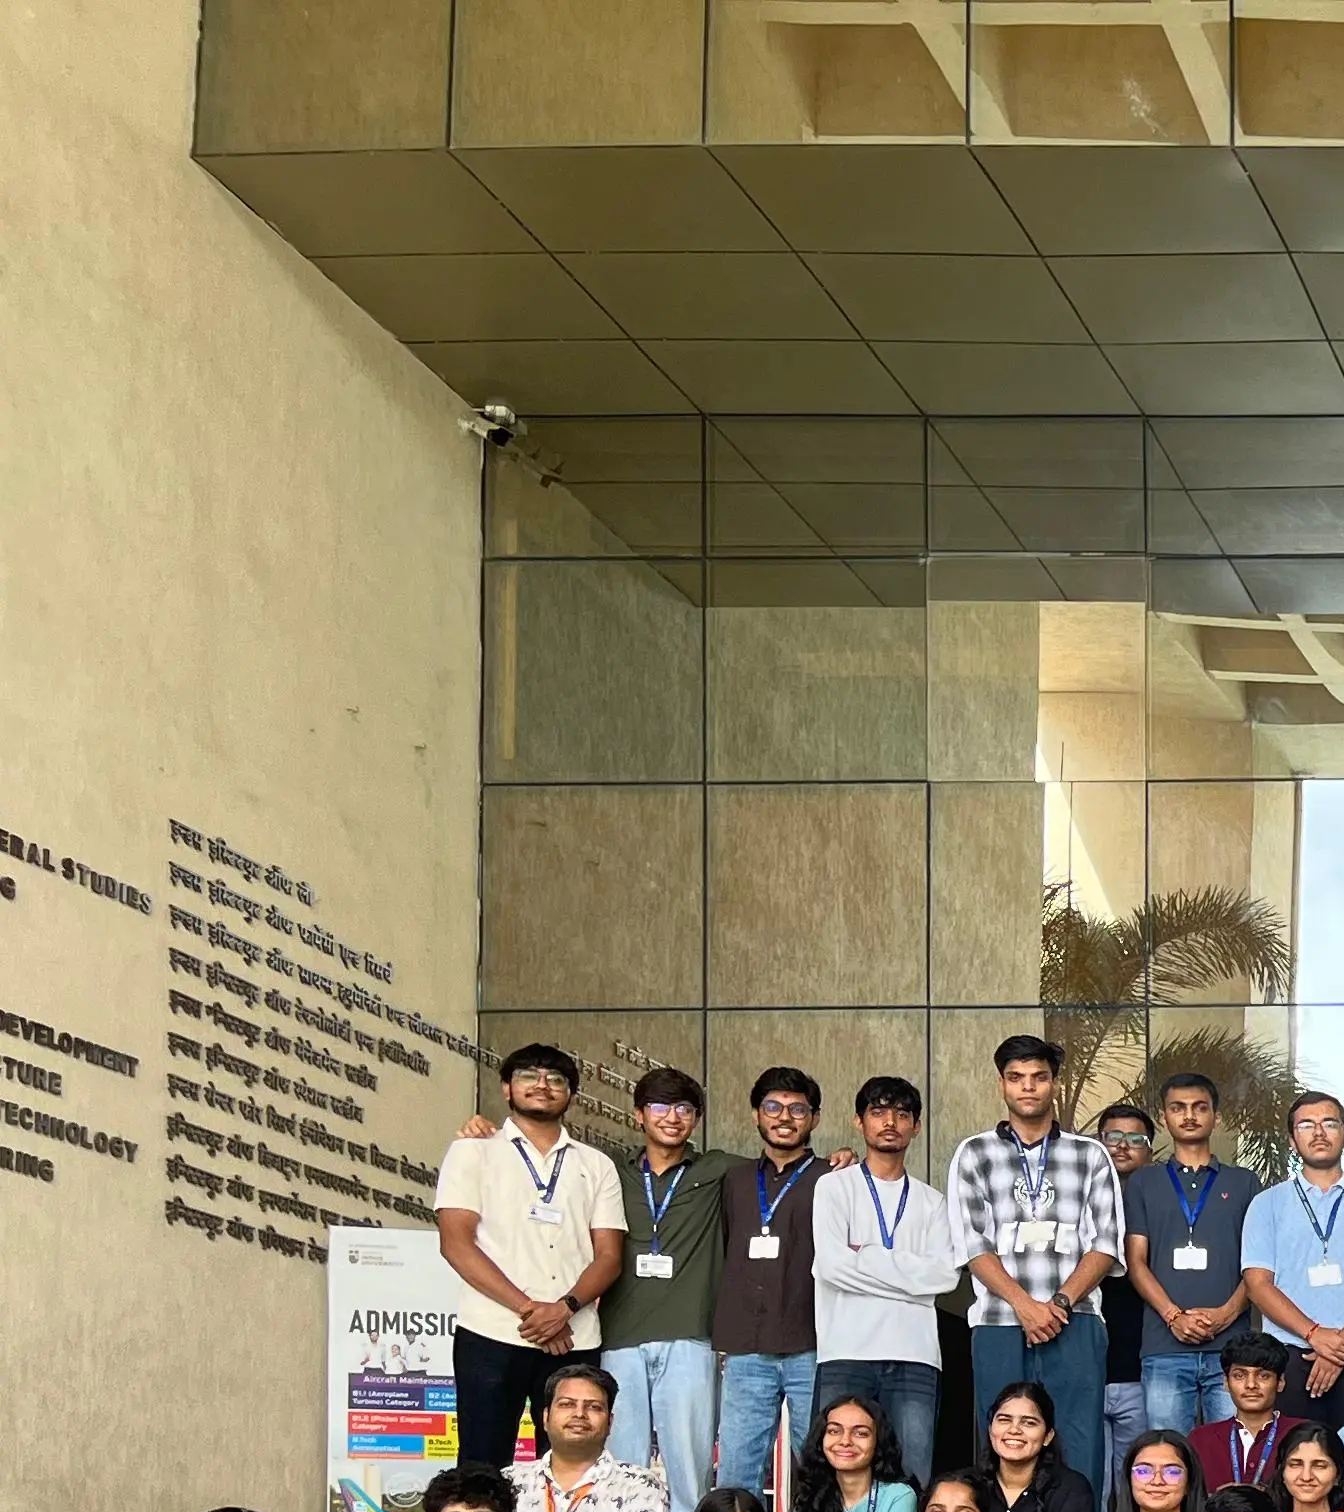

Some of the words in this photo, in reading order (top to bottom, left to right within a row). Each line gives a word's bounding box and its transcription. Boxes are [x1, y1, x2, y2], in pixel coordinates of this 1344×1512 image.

[61, 857, 152, 915] STUDIES
[0, 1056, 62, 1095] TURE
[0, 1099, 138, 1163] ECHNOLOGY
[363, 1376, 397, 1384] Aircraft
[400, 1377, 453, 1385] Maintenance
